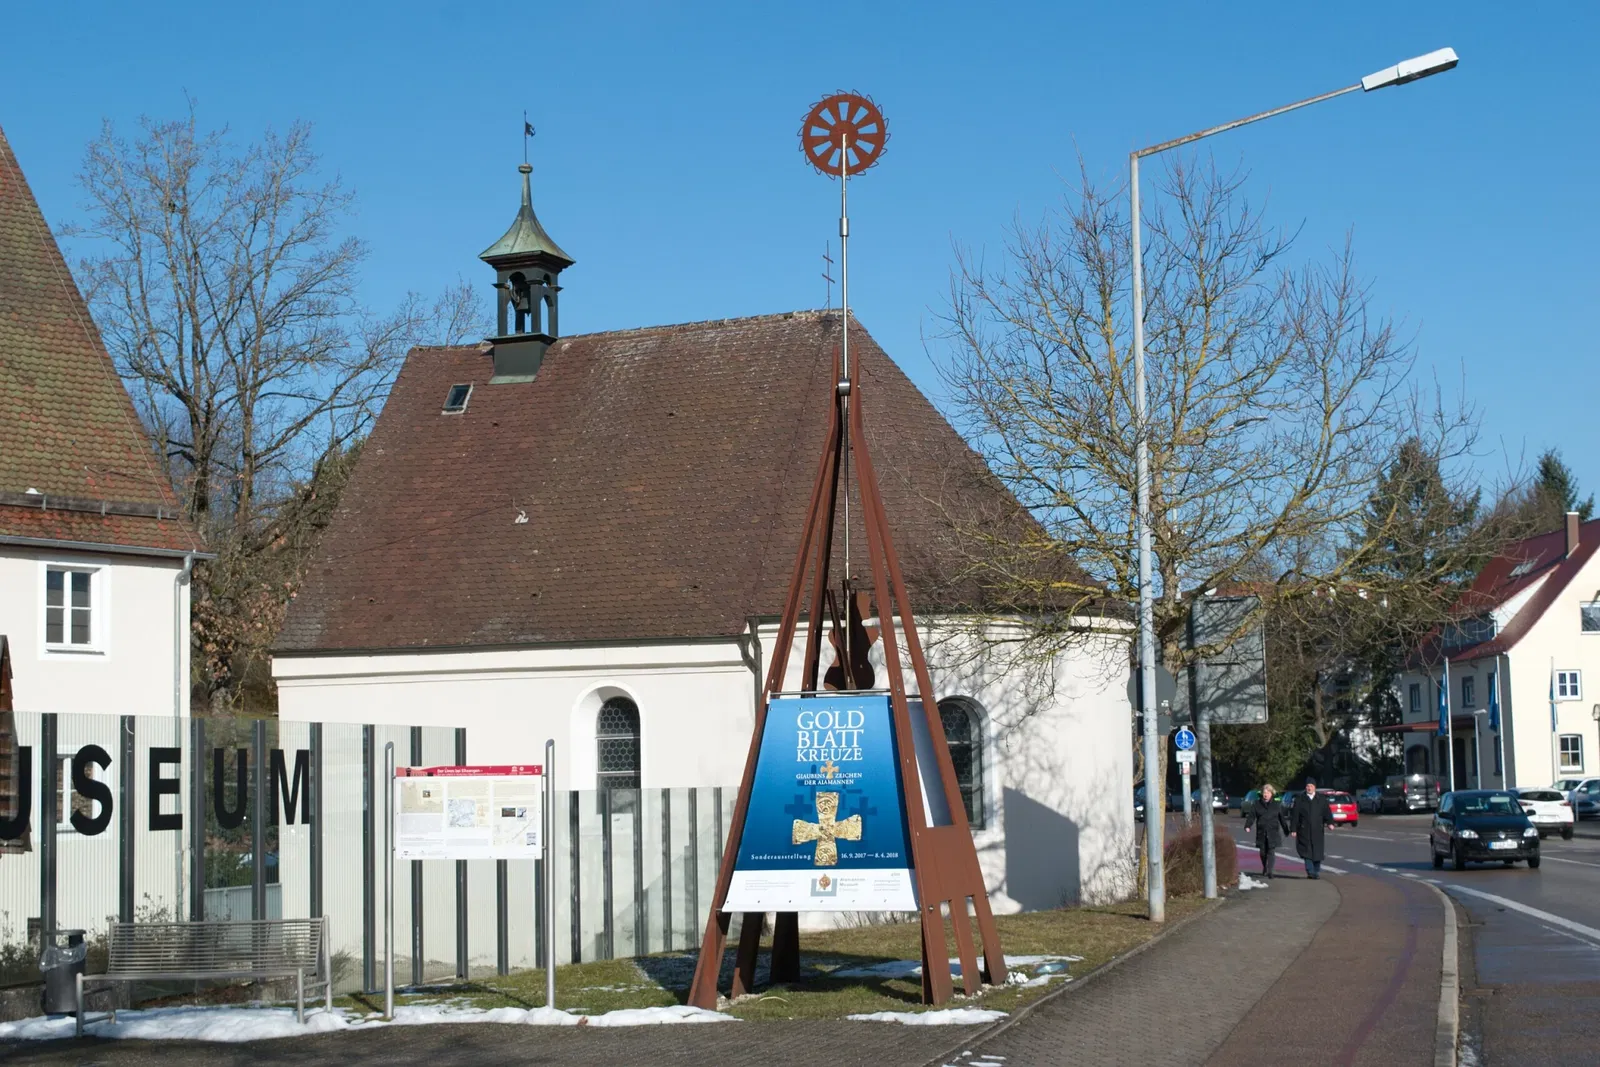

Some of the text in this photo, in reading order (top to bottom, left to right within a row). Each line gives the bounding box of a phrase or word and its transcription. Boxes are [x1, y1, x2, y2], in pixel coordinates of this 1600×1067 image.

[797, 710, 865, 730] GOLD
[796, 729, 865, 749] BLATT
[796, 748, 863, 762] KREUZE
[751, 853, 811, 861] Sonderausstellung
